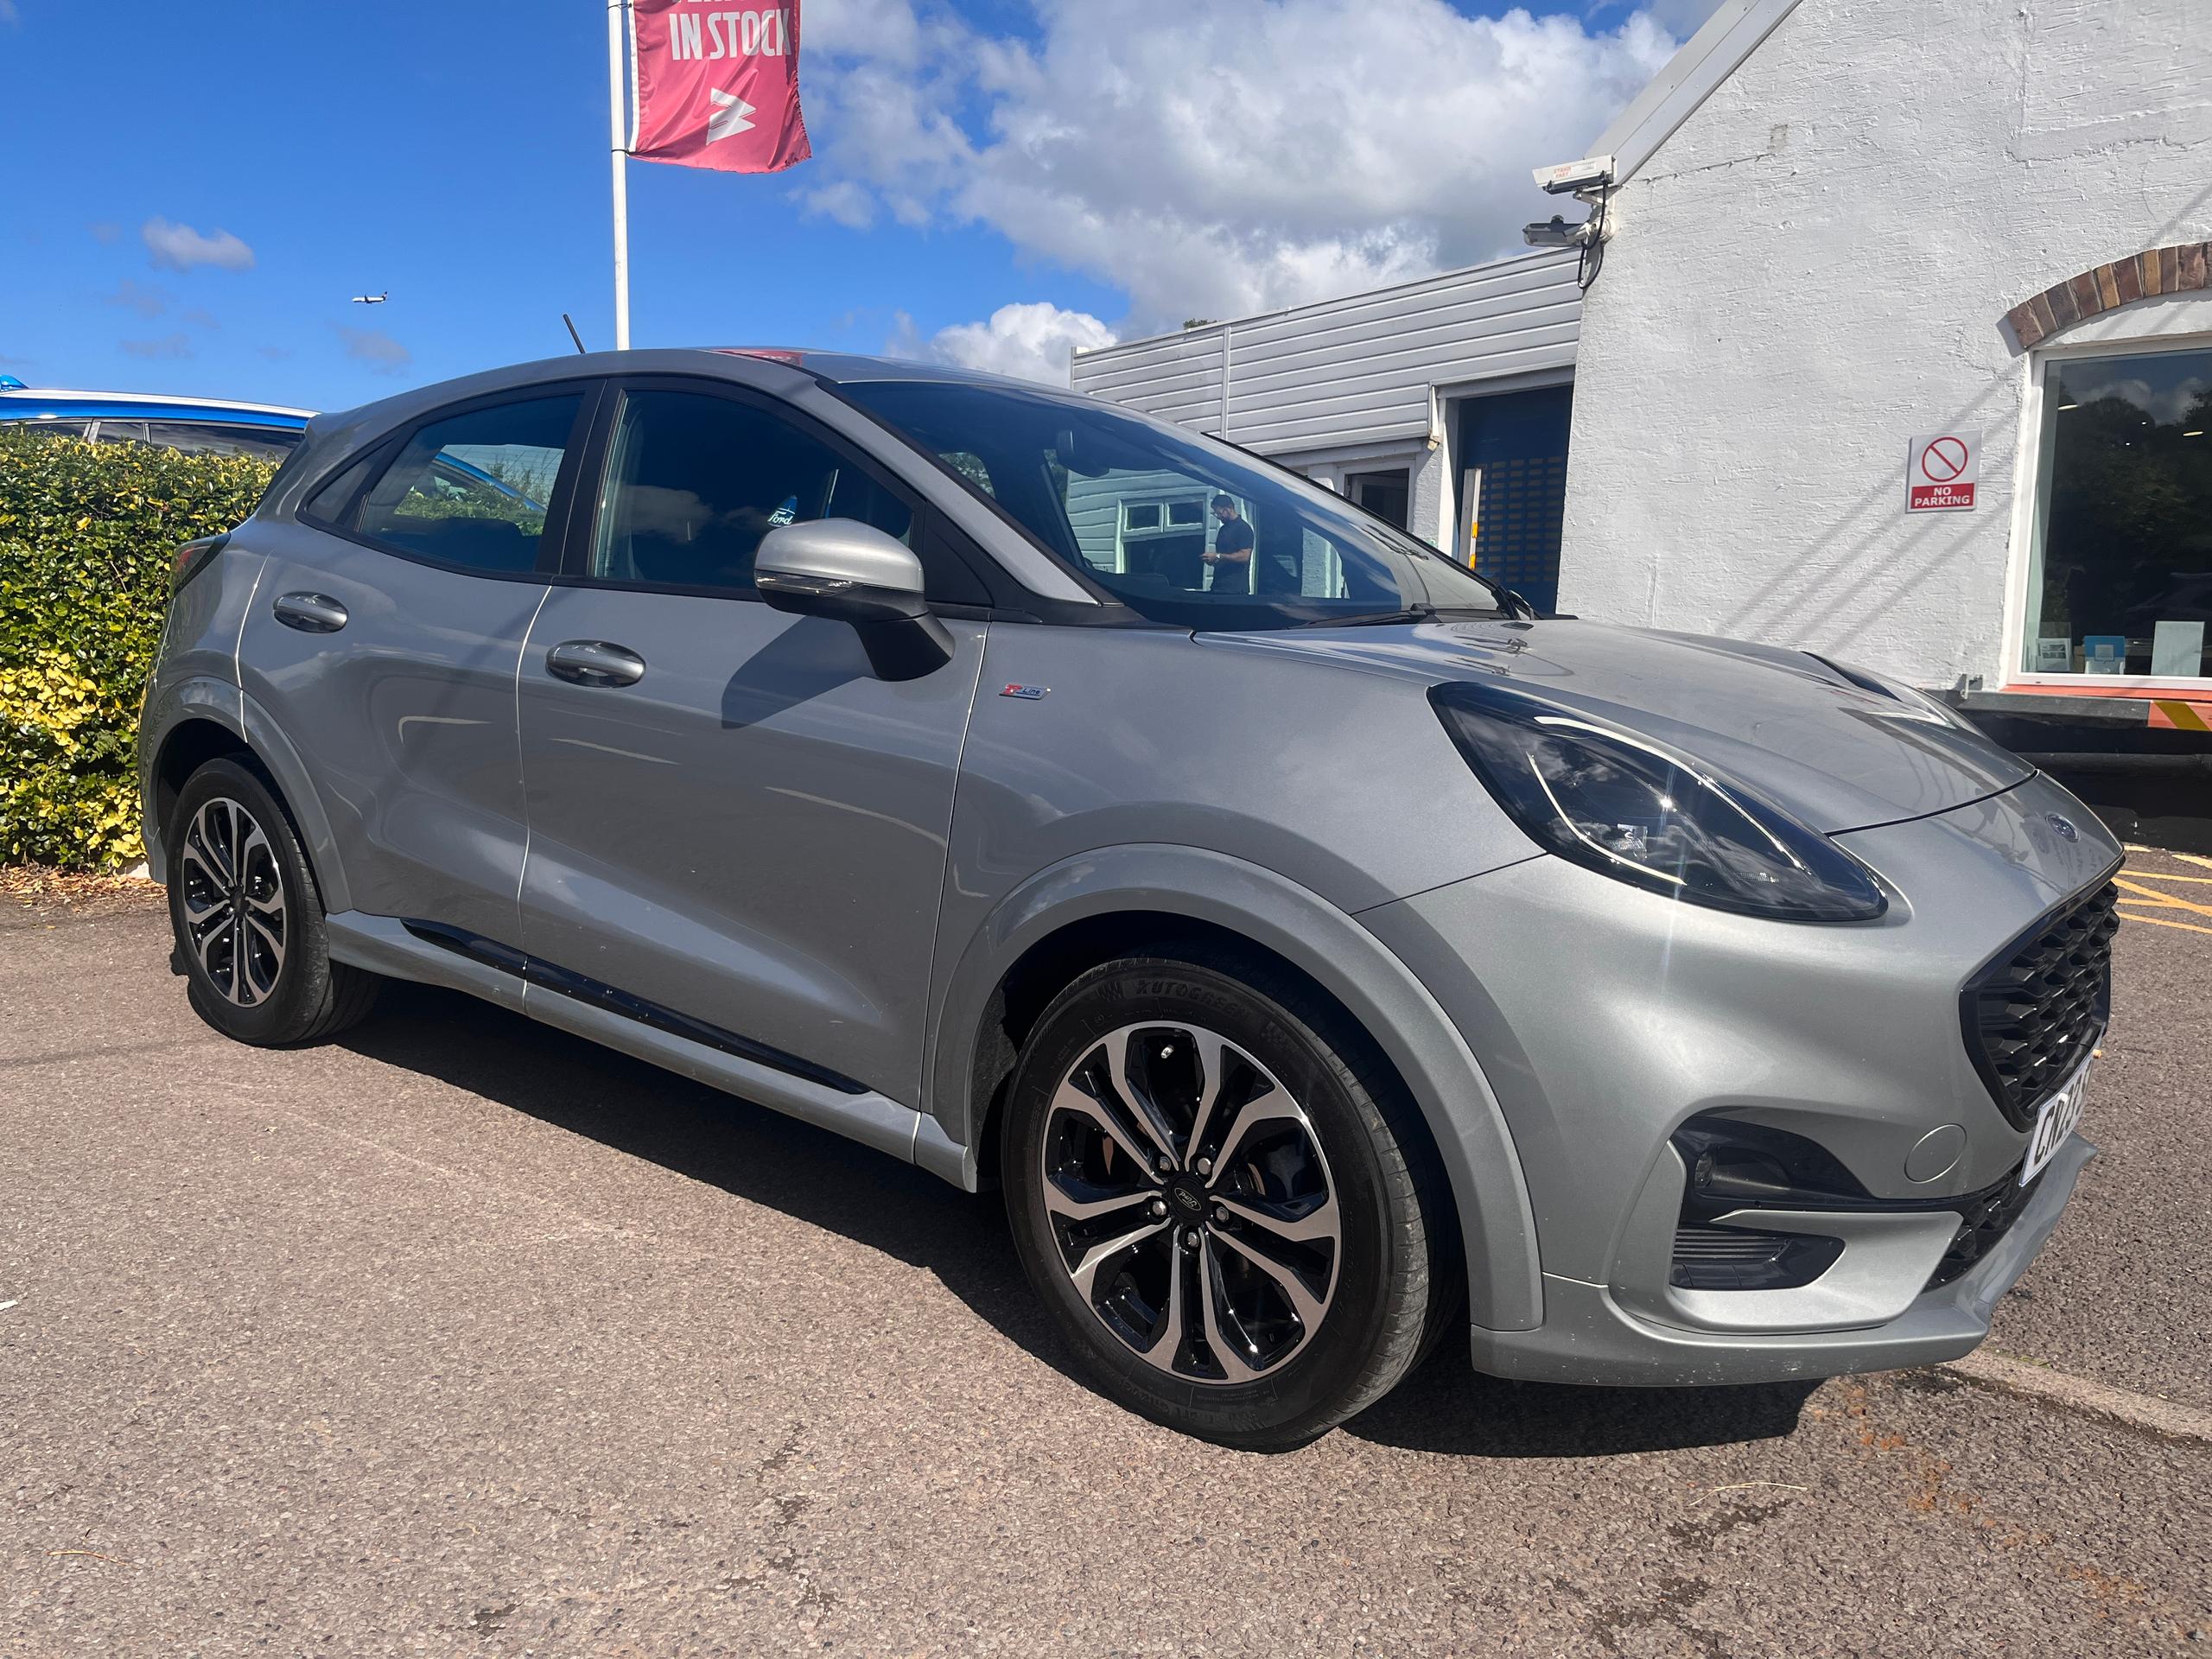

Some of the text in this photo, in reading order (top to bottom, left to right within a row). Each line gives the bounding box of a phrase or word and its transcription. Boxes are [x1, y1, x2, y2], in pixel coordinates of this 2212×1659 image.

[668, 8, 792, 60] IN STOCK
[1933, 486, 1952, 496] NO
[1914, 495, 1970, 506] PARKING
[767, 510, 793, 525] Ford
